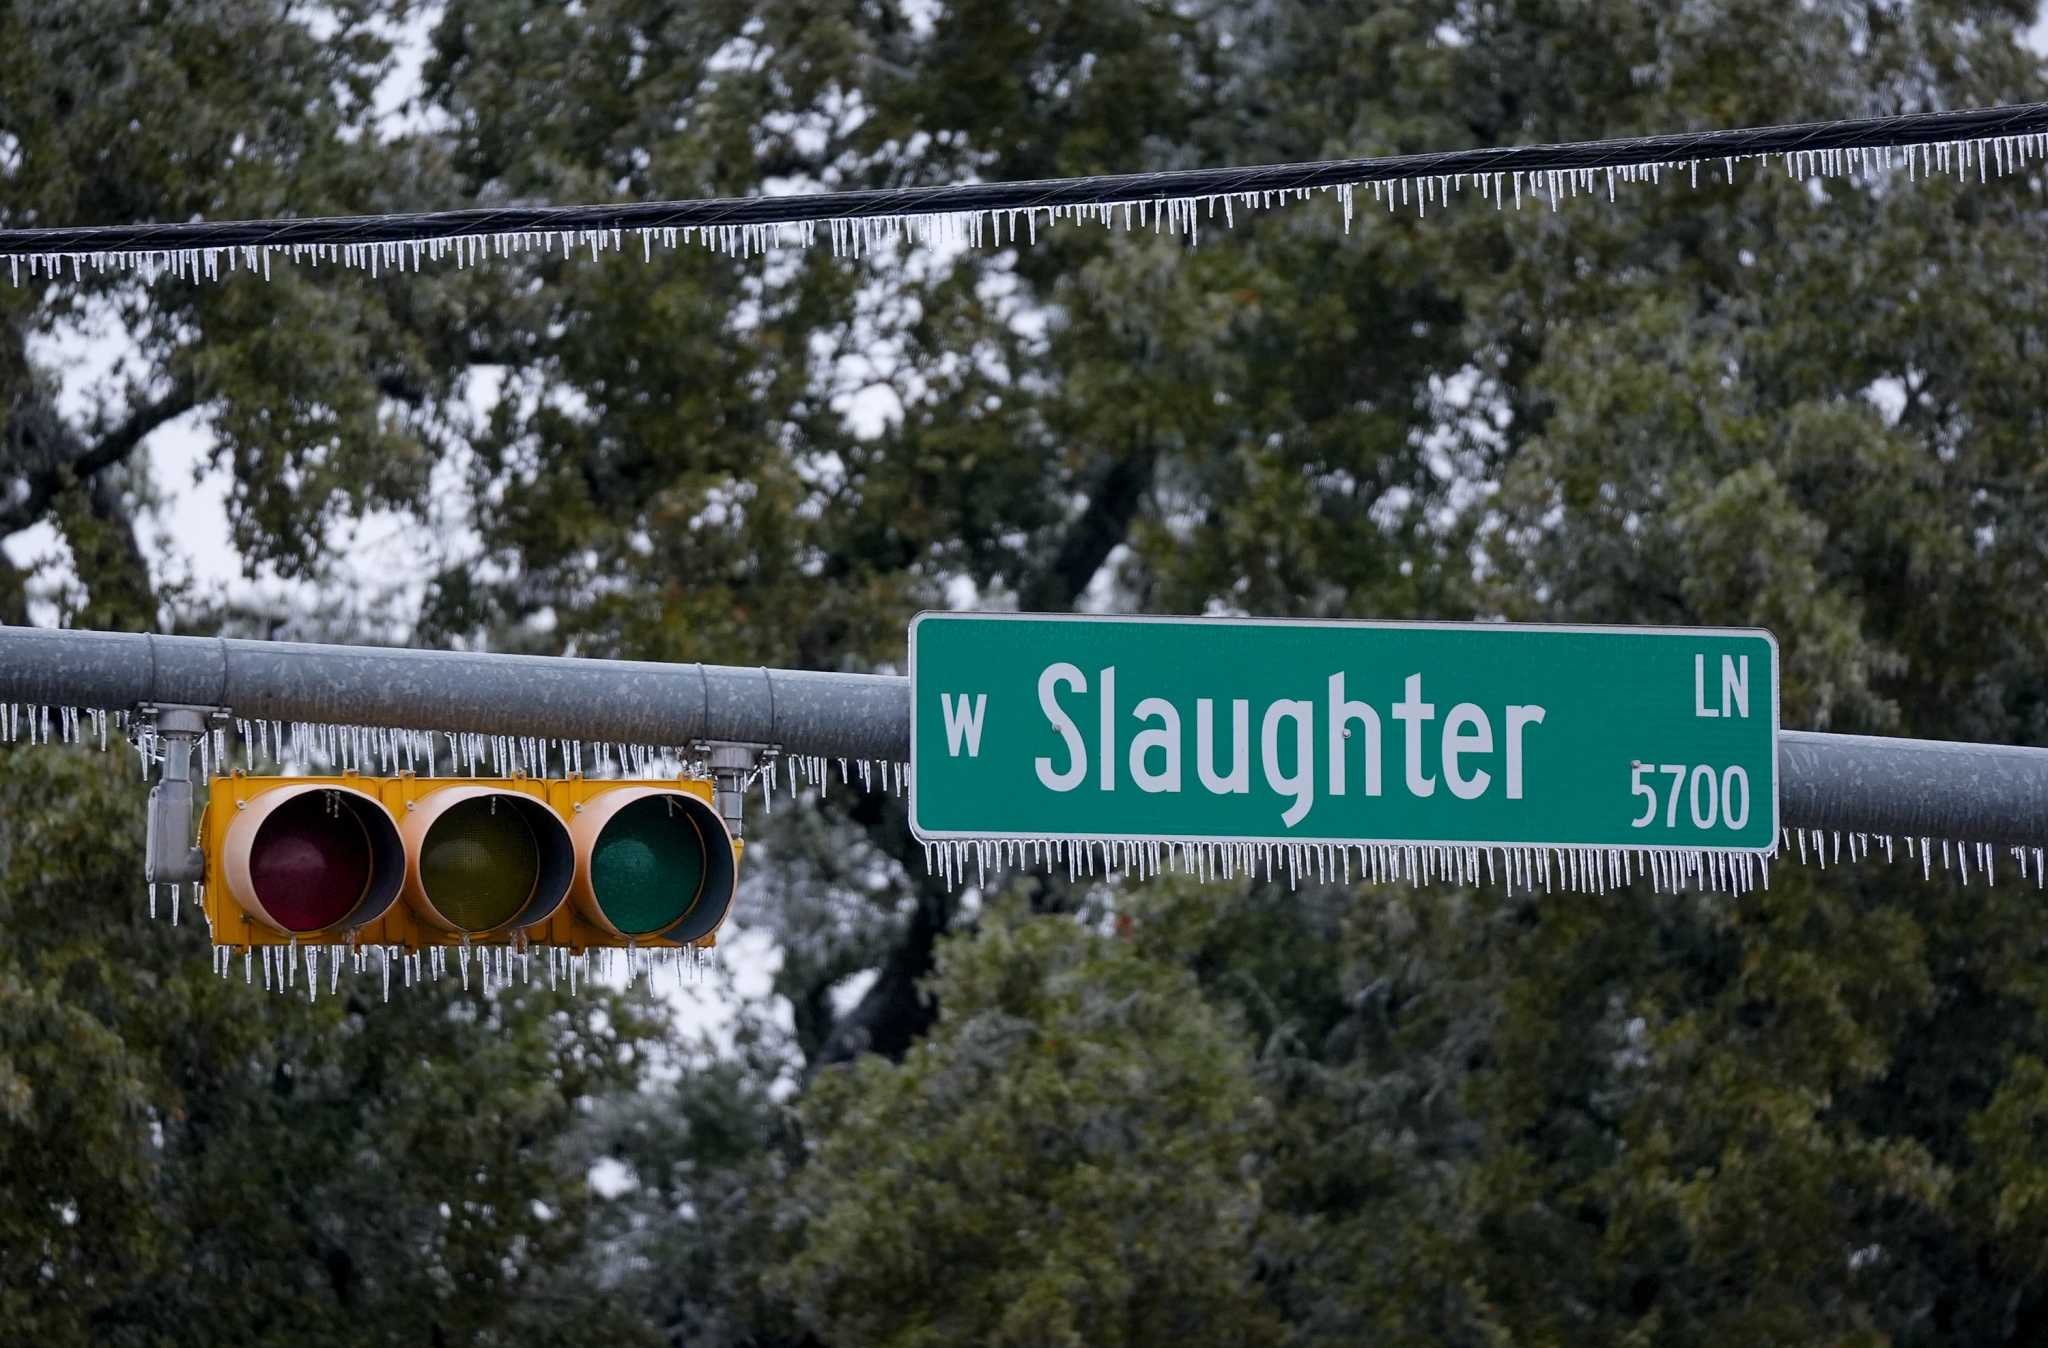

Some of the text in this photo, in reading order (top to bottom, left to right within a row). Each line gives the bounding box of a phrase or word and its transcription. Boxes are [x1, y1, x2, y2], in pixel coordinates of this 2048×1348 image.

[1694, 654, 1749, 718] LN
[940, 662, 1547, 828] W Slaughter
[1630, 763, 1750, 830] 5700
